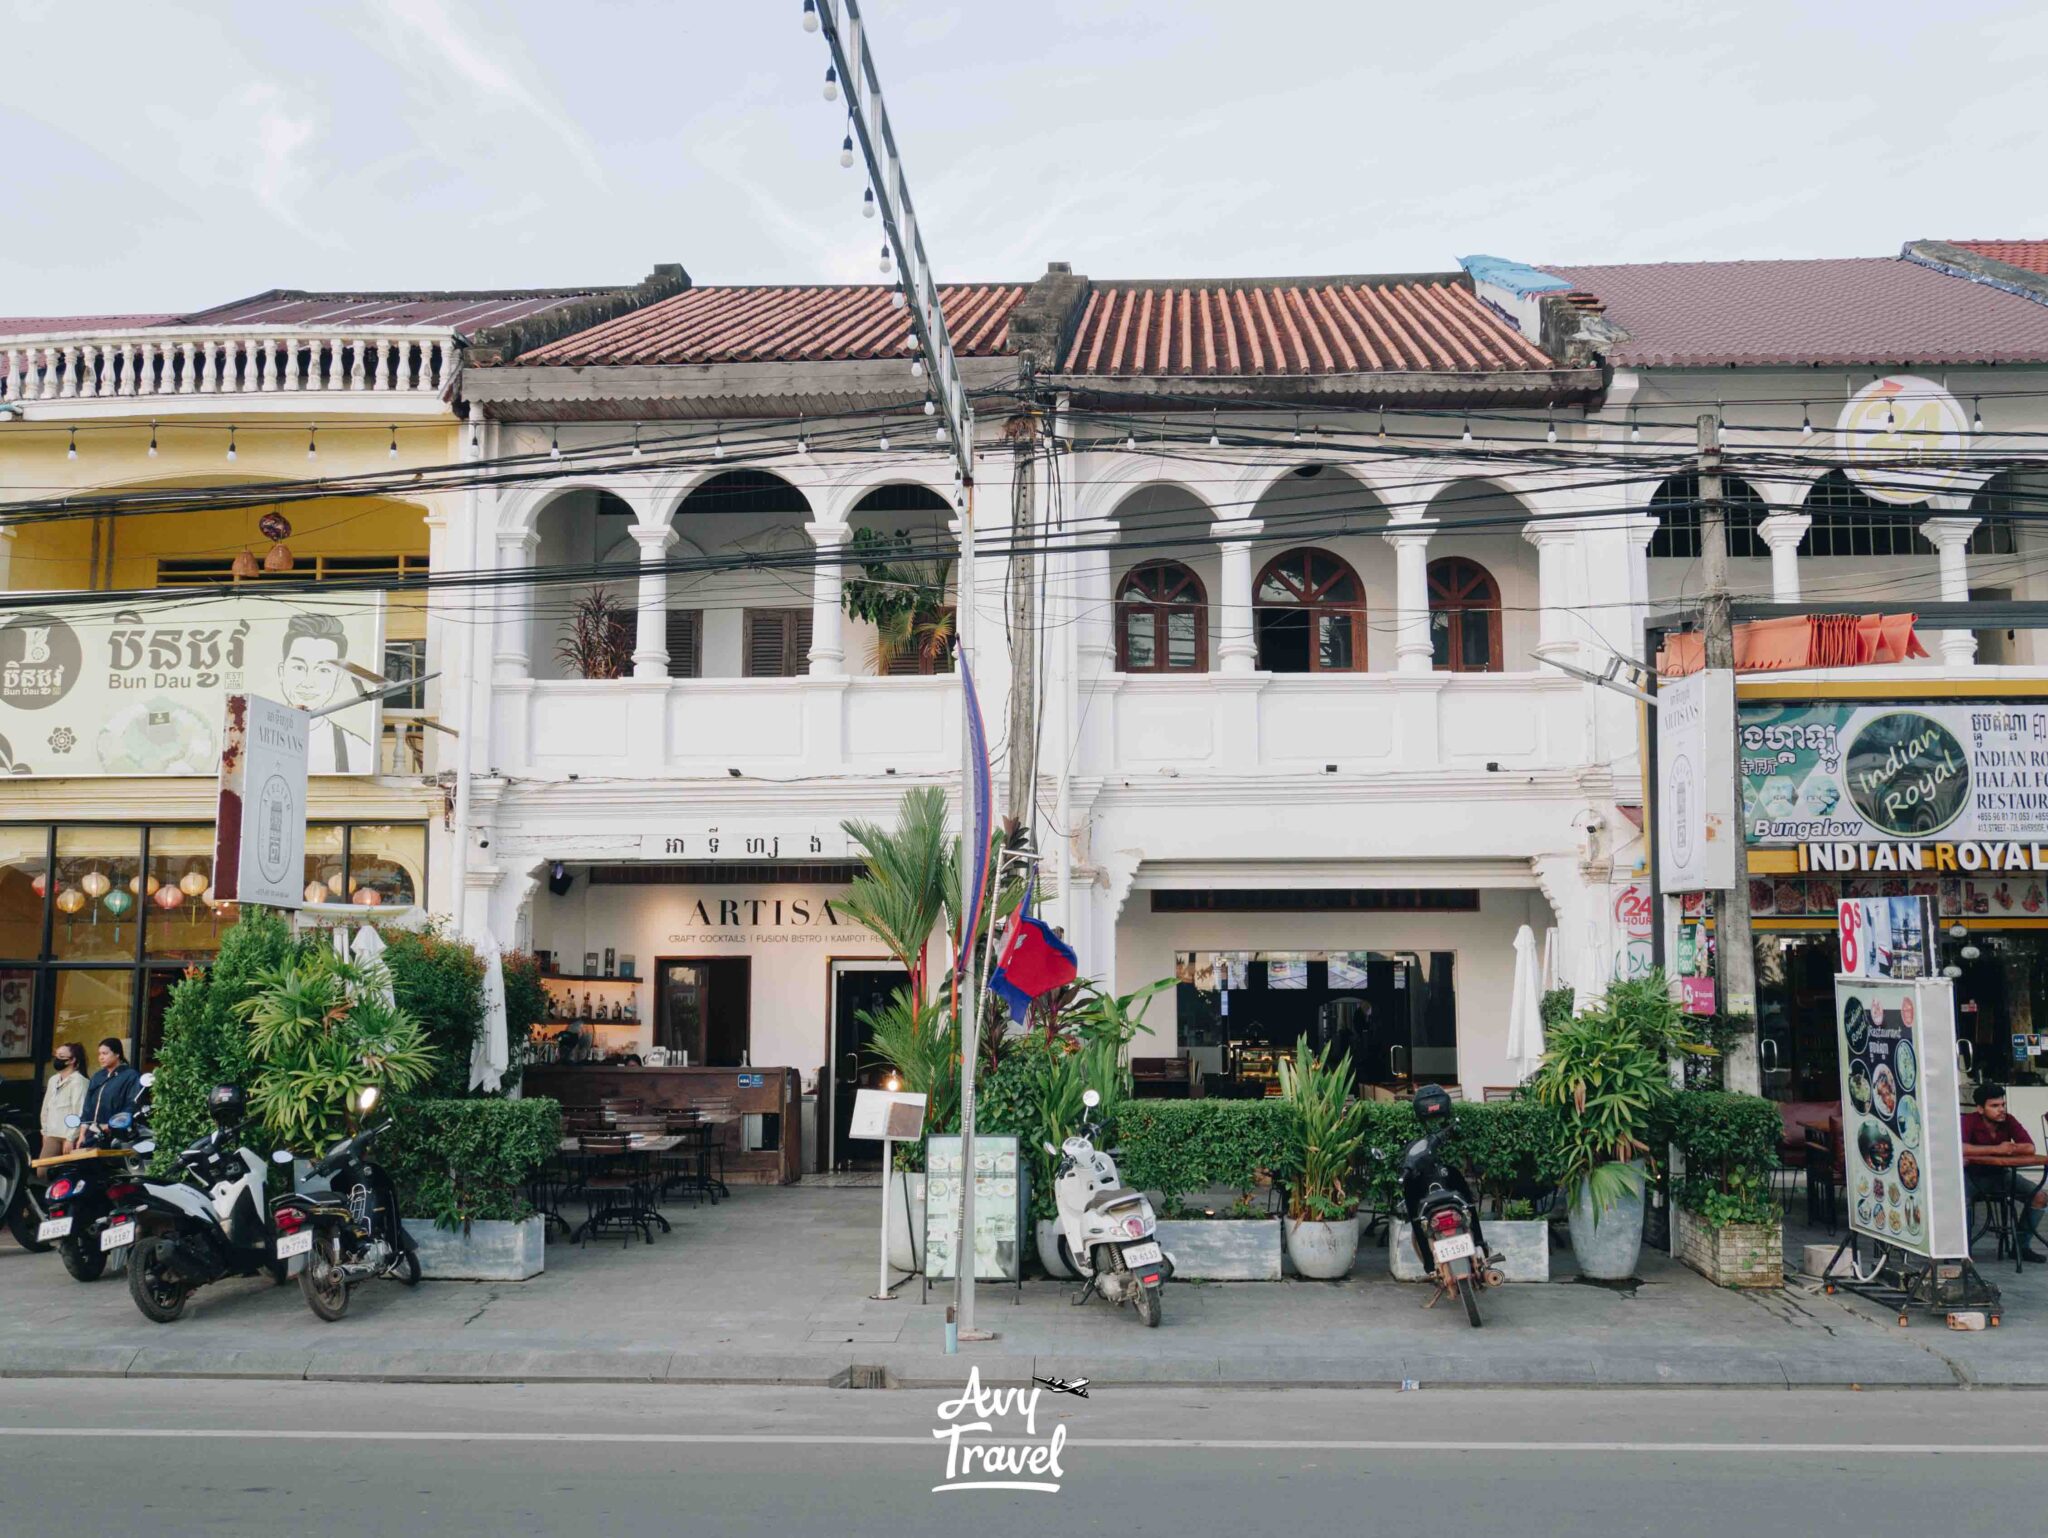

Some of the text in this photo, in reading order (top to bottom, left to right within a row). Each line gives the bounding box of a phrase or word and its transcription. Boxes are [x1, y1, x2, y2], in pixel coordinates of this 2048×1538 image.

[109, 673, 191, 689] Bun Dau
[4, 687, 39, 695] Bun Dau
[1859, 729, 1941, 795] Indian
[1974, 751, 2026, 767] INDIAN
[1884, 749, 1958, 820] Royal
[1976, 772, 2031, 788] HALAL
[1753, 818, 1863, 840] Bungalow
[1798, 842, 2048, 872] INDIAN ROYAL
[1624, 896, 1652, 917] 24
[668, 934, 696, 943] CRAFT
[699, 934, 746, 943] COCKTAILS
[756, 934, 789, 943] FUSION
[791, 934, 822, 943] BISTRO
[831, 934, 865, 943] KAMPOT
